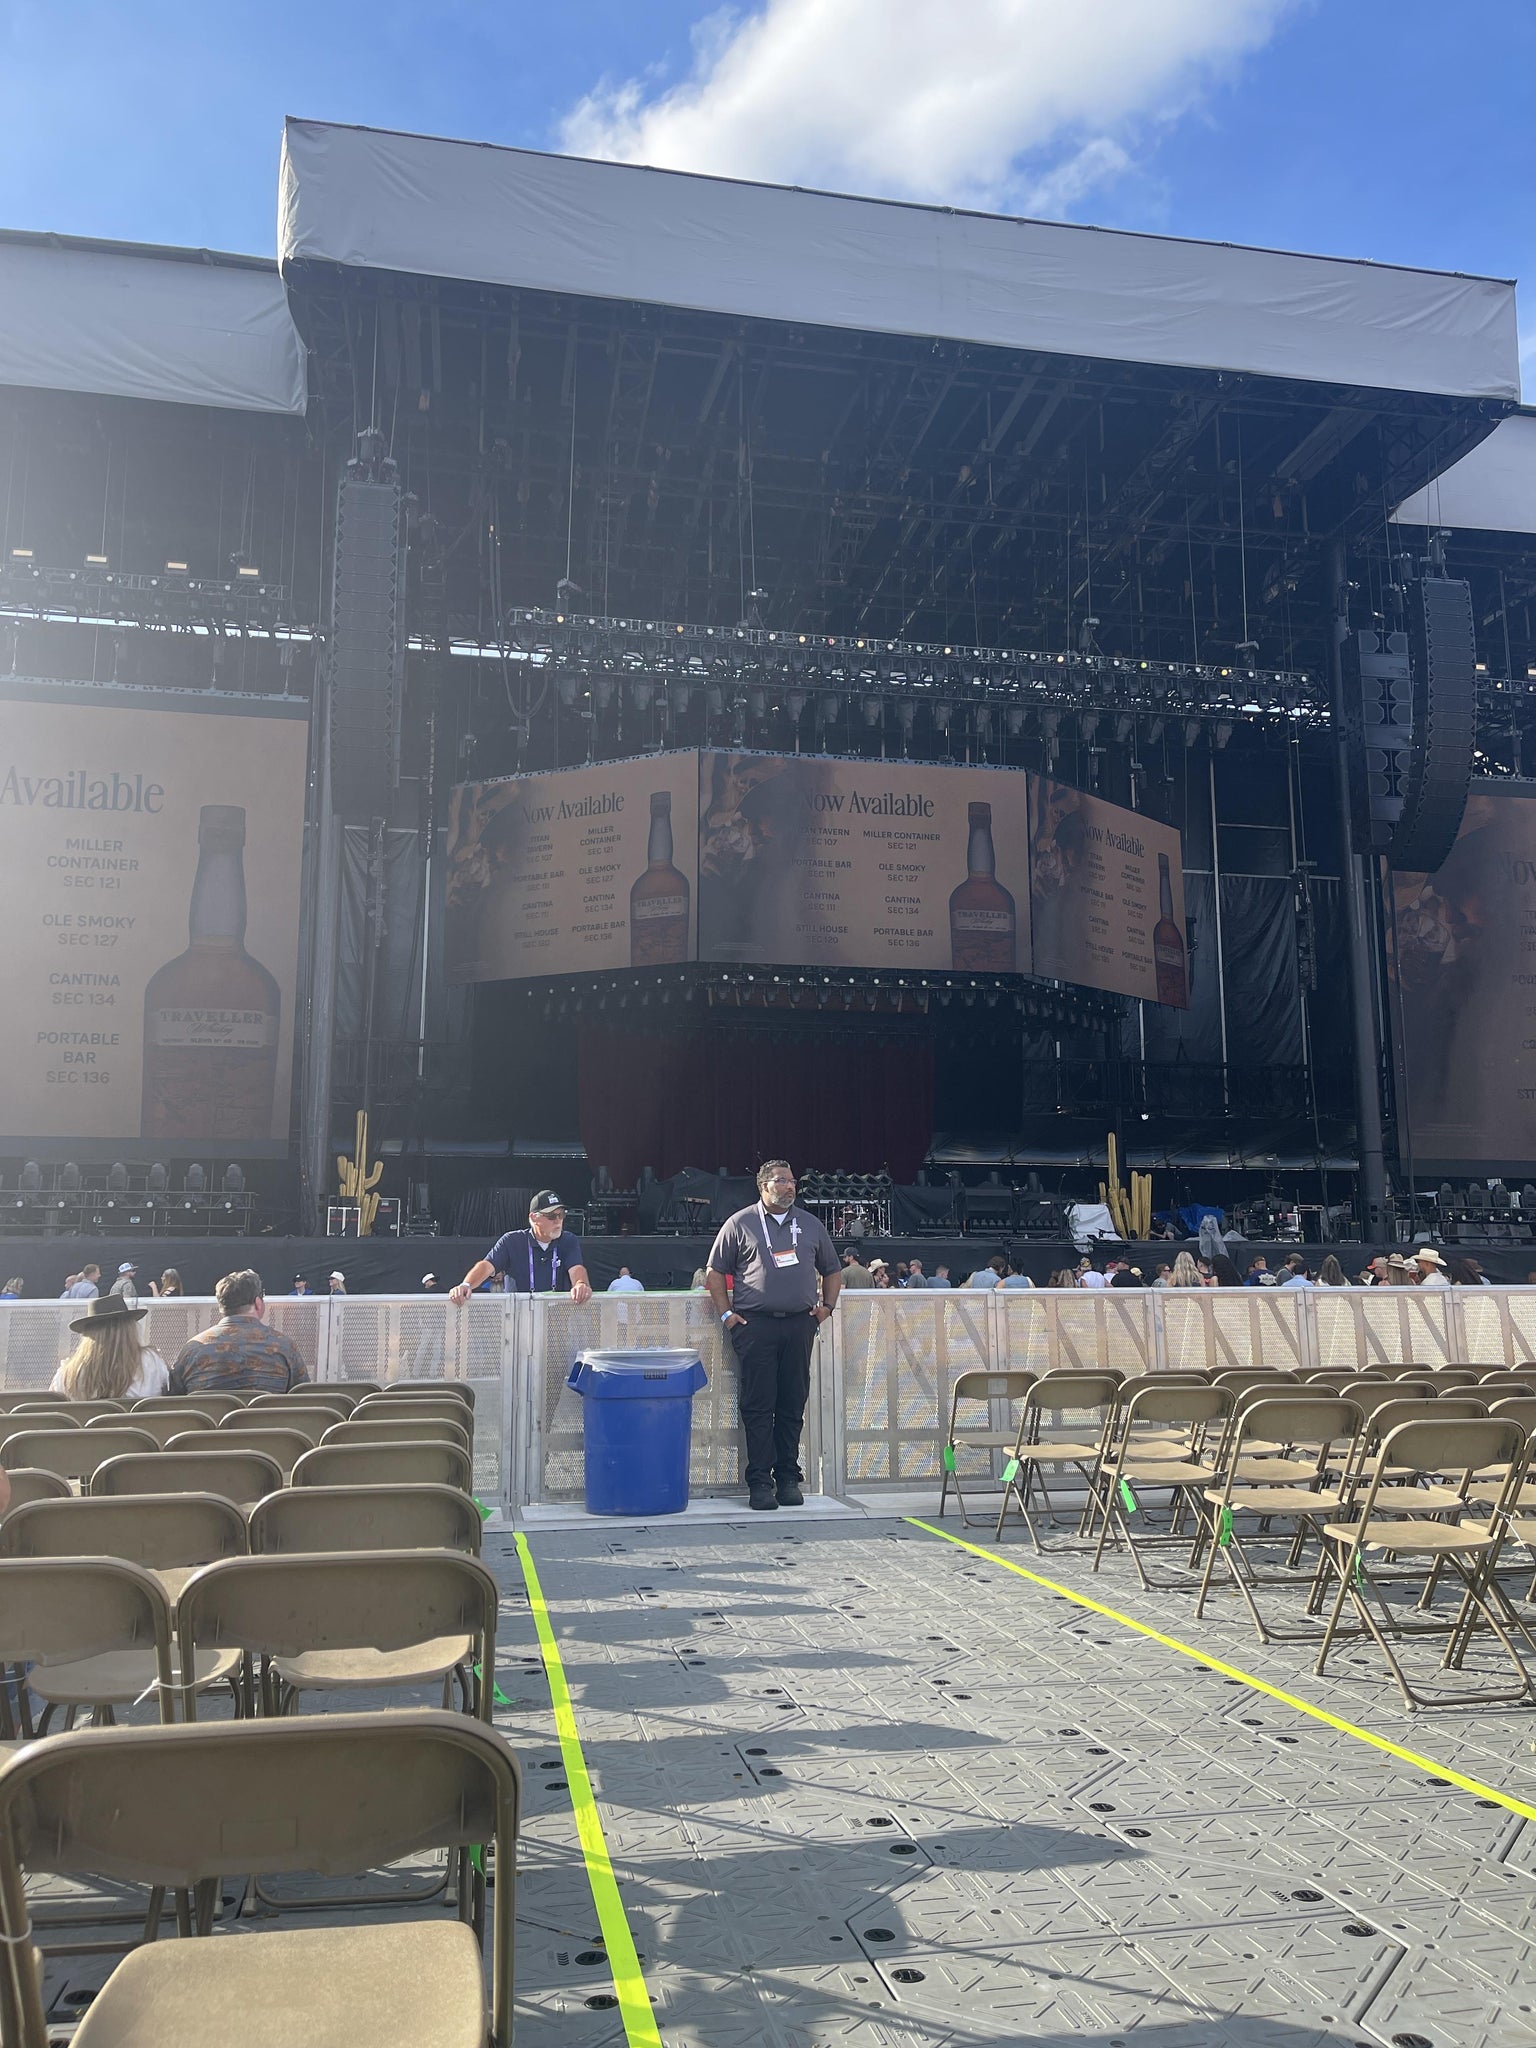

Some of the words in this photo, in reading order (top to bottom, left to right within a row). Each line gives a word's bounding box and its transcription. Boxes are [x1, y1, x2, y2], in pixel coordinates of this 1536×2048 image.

[0, 765, 165, 814] Available
[556, 791, 625, 822] Available
[849, 790, 935, 818] Available
[587, 825, 615, 835] MILLER
[818, 827, 850, 836] TAVERN
[579, 834, 622, 846] CONTAINER
[863, 830, 892, 840] MILLER
[894, 832, 941, 842] CONTAINER
[65, 838, 124, 853] MILLER
[824, 838, 838, 846] 107
[887, 841, 903, 850] SEC
[905, 841, 918, 851] 121
[1106, 827, 1145, 858] Available
[47, 855, 140, 871] CONTAINER
[835, 859, 853, 869] BAR
[878, 863, 894, 872] OLE
[896, 864, 926, 873] SMOKY
[550, 870, 565, 879] BAR
[578, 867, 593, 875] OLE
[594, 864, 622, 874] SMOKY
[808, 870, 824, 878] SEC
[63, 875, 94, 888] SEC
[99, 876, 121, 889] 121
[887, 873, 903, 882] SEC
[904, 874, 918, 883] 127
[583, 893, 615, 903] CANTINA
[803, 892, 840, 901] CANTINA
[884, 895, 922, 905] CANTINA
[827, 903, 836, 911] 111
[887, 906, 903, 914] SEC
[904, 906, 919, 915] 134
[42, 913, 72, 927] OLE
[77, 914, 136, 930] SMOKY
[571, 922, 608, 933] PORTABLE
[610, 920, 626, 929] BAR
[819, 925, 849, 934] HOUSE
[873, 927, 915, 937] PORTABLE
[917, 928, 934, 937] BAR
[57, 932, 91, 946] SEC
[94, 934, 118, 947] 127
[887, 938, 904, 947] SEC
[905, 938, 920, 948] 136
[48, 972, 122, 988] CANTINA
[51, 991, 86, 1005] SEC
[88, 993, 116, 1006] 134
[160, 1010, 264, 1024] TRAVELLER
[36, 1030, 120, 1046] PORTABLE
[63, 1050, 97, 1064] BAR
[46, 1070, 79, 1084] SEC
[82, 1071, 111, 1085] 136
